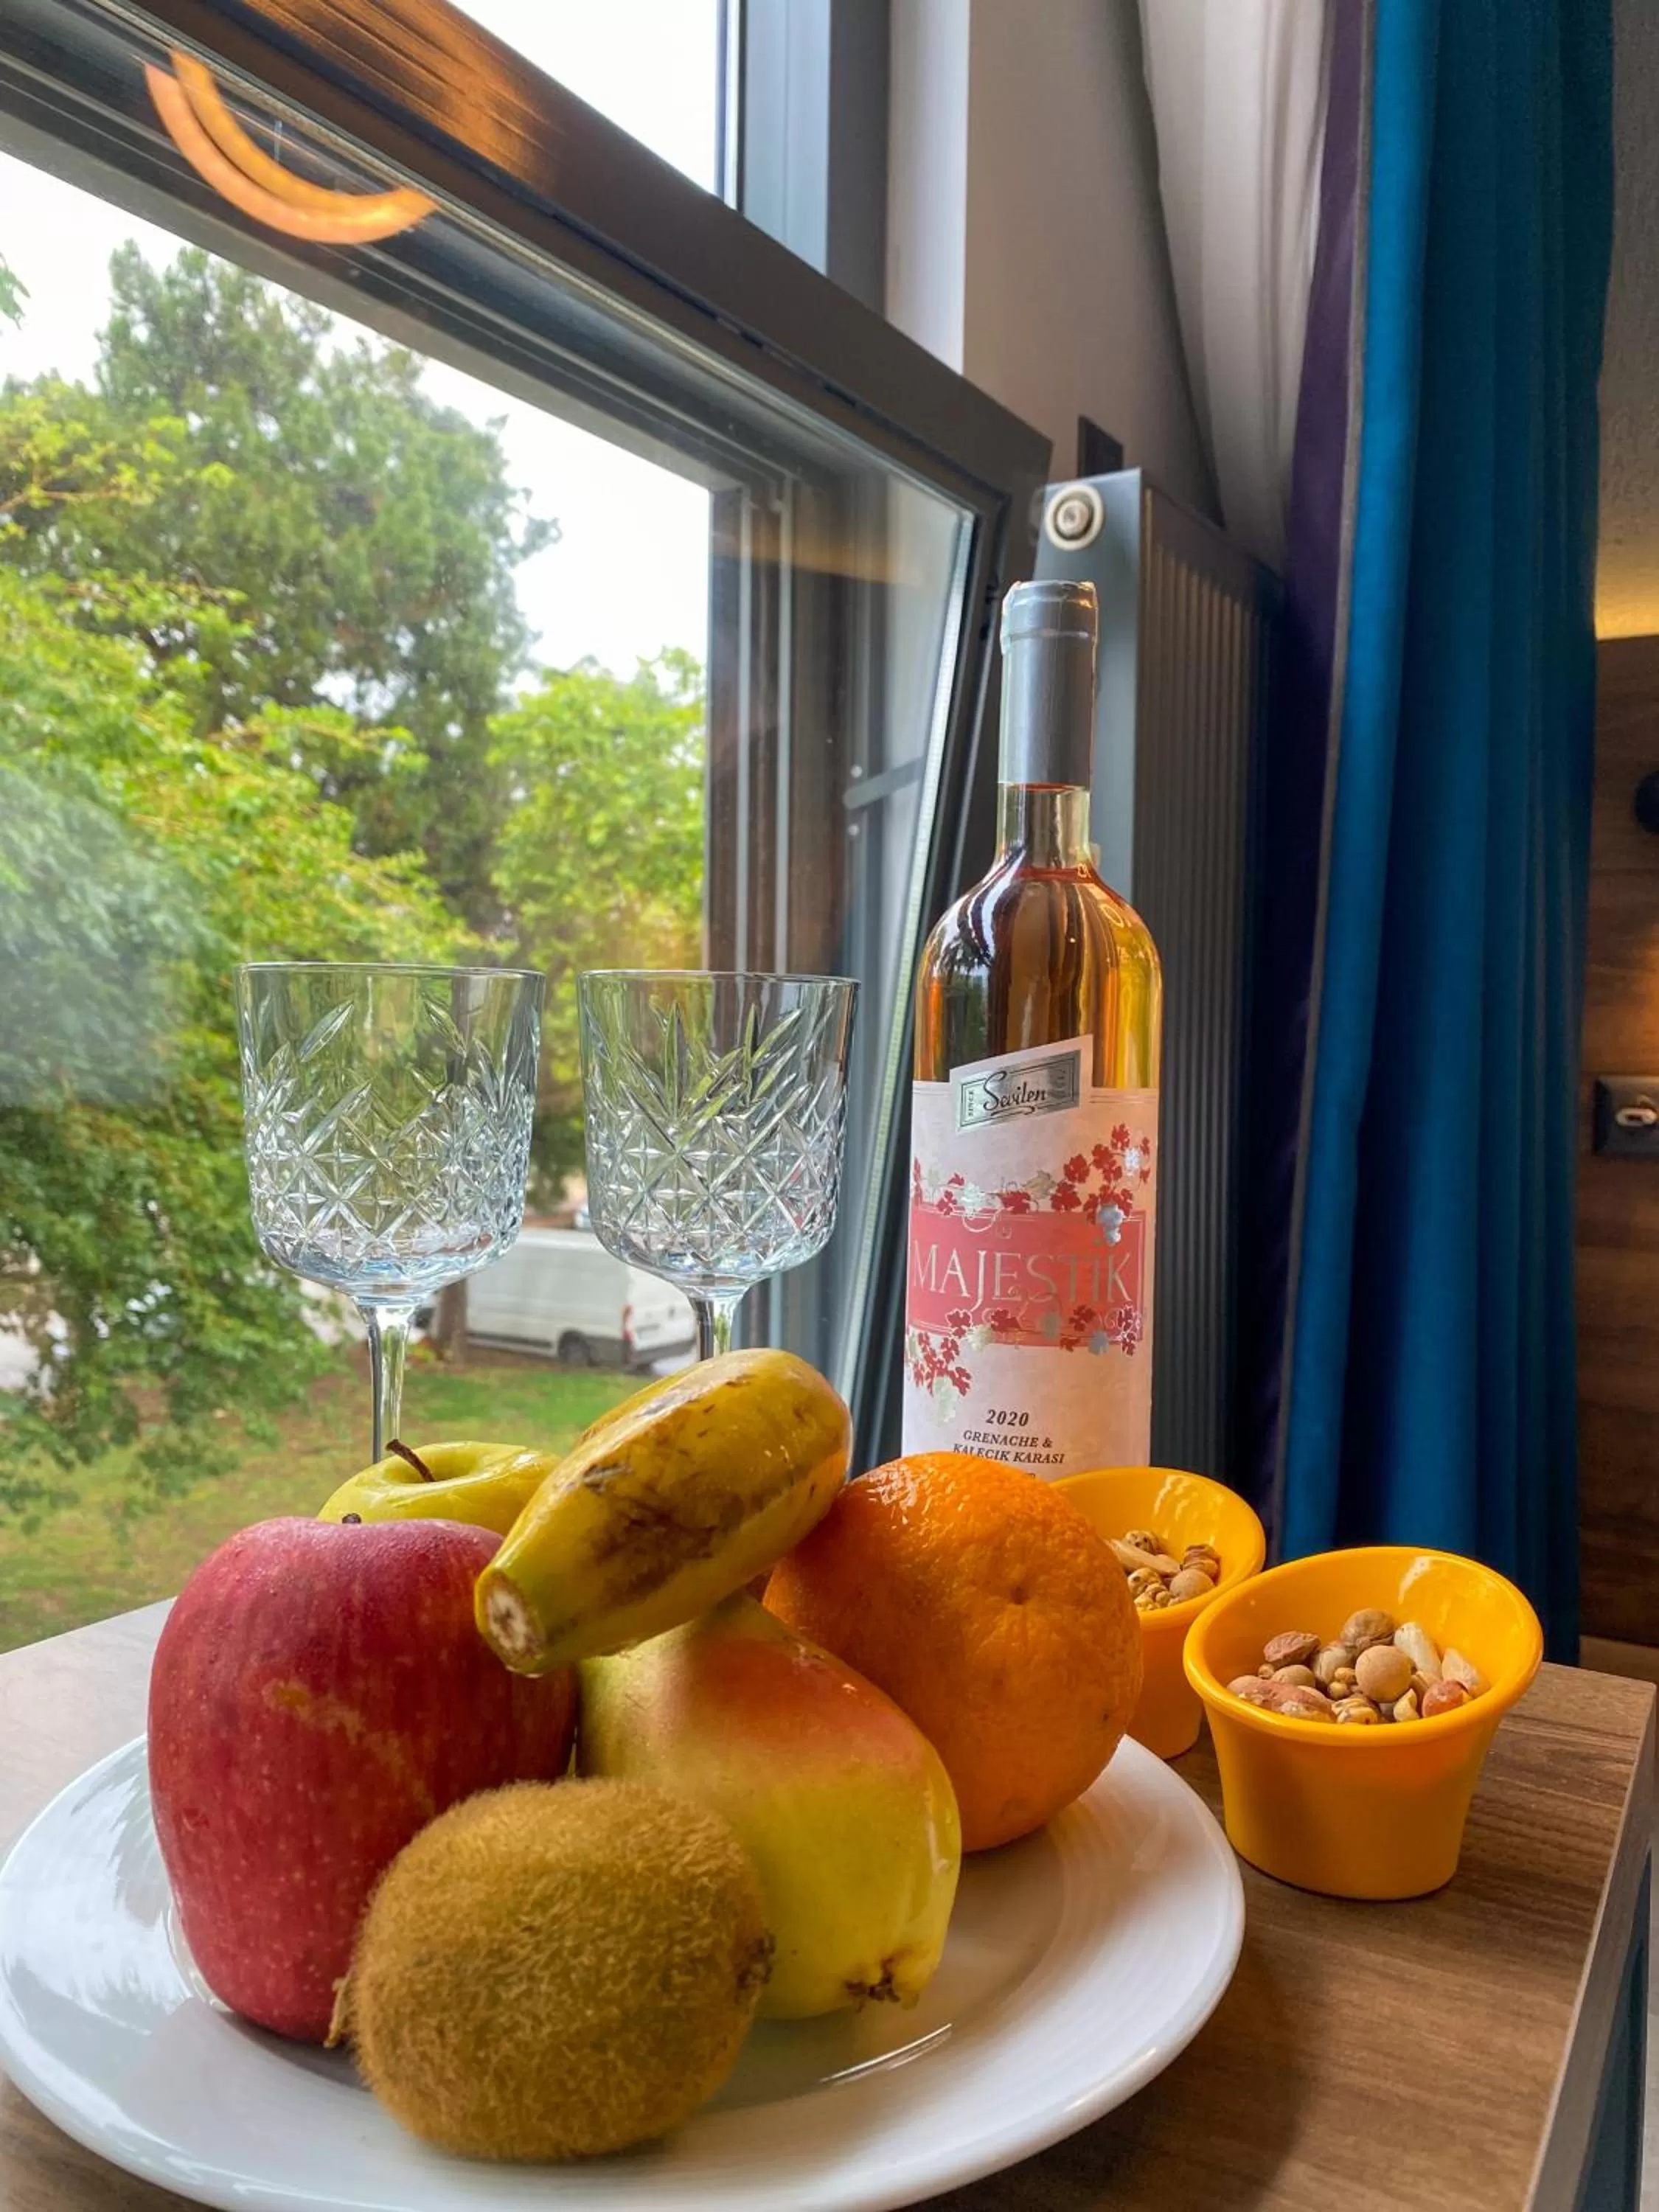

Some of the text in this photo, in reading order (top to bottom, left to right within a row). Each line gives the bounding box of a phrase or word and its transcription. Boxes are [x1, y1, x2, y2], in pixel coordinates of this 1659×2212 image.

[985, 1409, 1029, 1427] 2020
[963, 1430, 1053, 1448] GRENACHE &
[1012, 1451, 1065, 1464] KARASI
